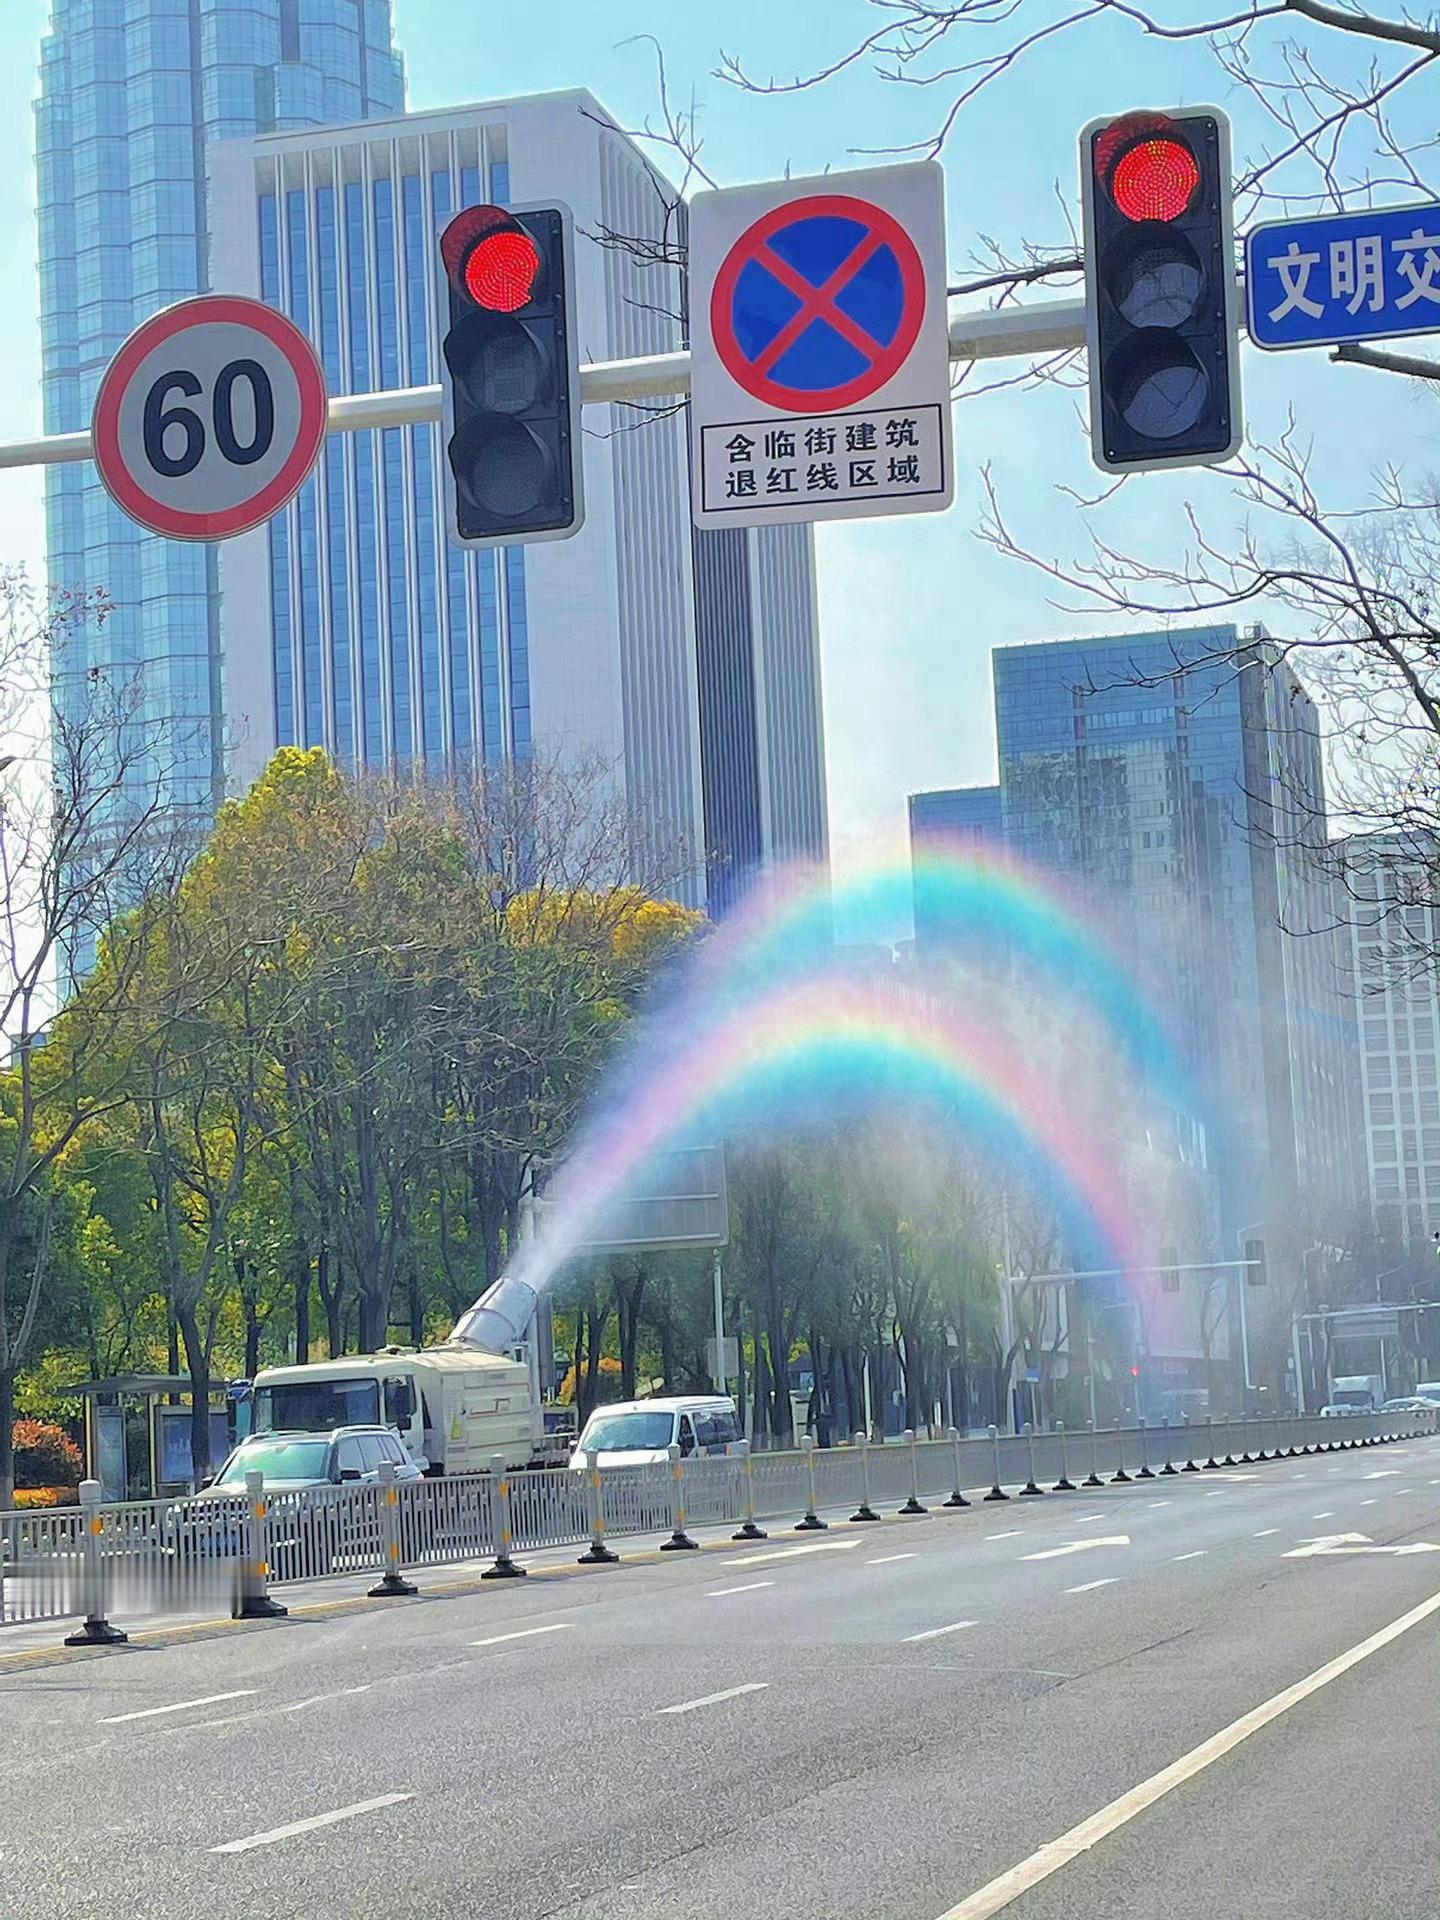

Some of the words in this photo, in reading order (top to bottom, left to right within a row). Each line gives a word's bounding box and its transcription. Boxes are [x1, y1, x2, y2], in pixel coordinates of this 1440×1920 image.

[1267, 228, 1440, 323] 文明交
[143, 358, 274, 477] 60
[725, 418, 919, 463] 含临街建筑
[726, 455, 920, 498] 退红线区域
